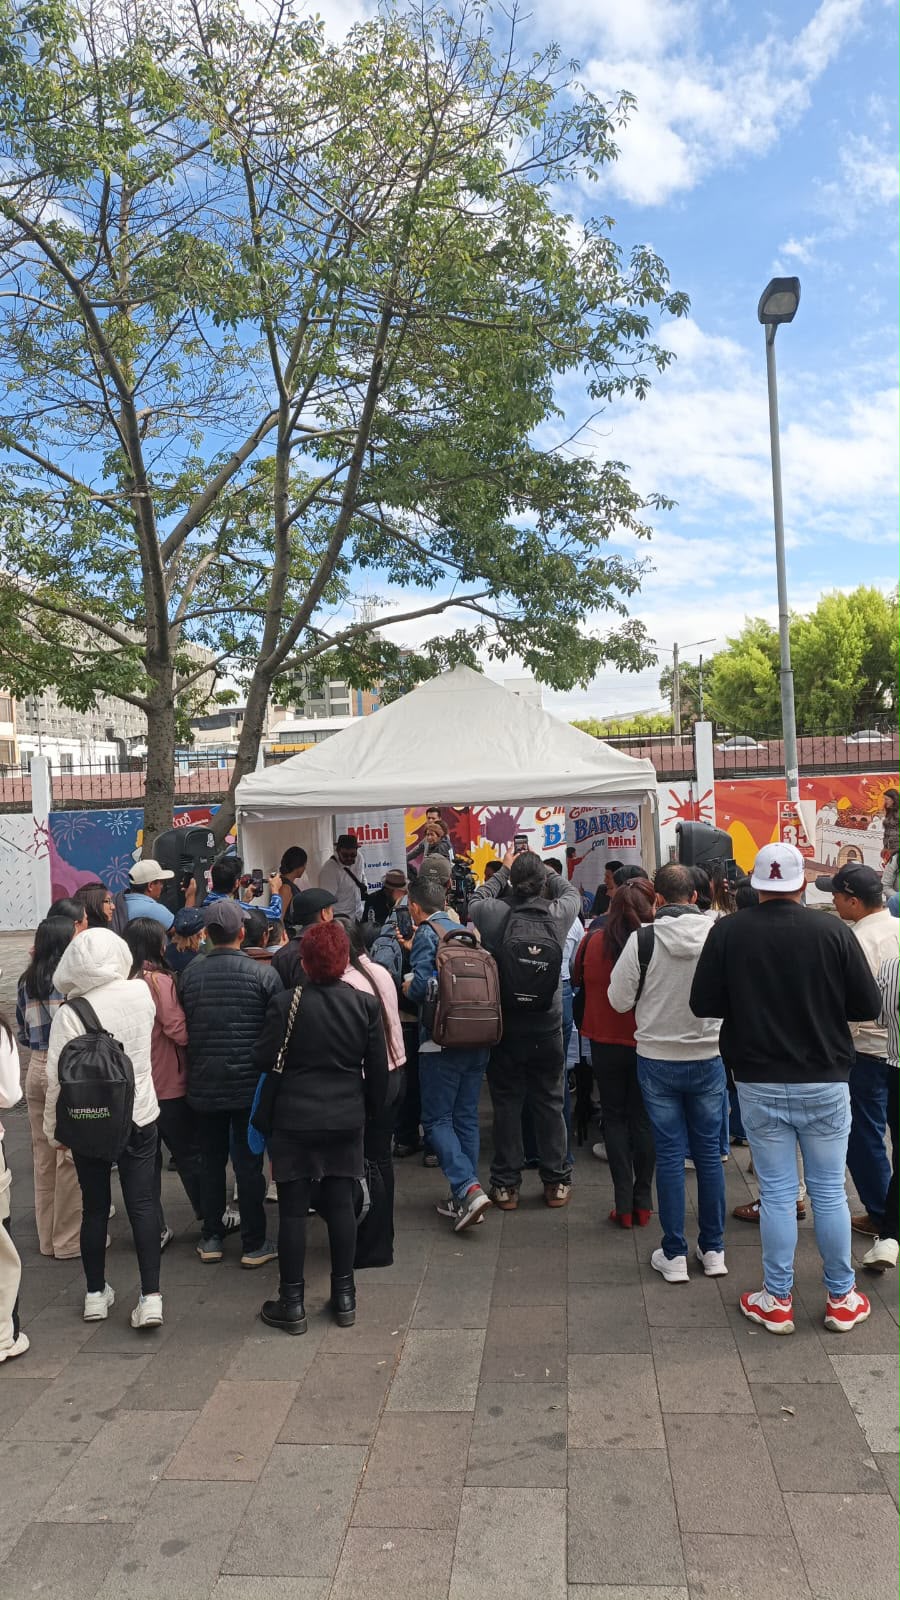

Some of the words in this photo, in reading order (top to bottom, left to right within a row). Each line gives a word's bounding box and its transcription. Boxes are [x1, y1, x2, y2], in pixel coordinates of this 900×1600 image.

[347, 822, 389, 841] Mini
[574, 811, 638, 843] BARRIO
[592, 839, 605, 848] con
[608, 835, 636, 846] Mini
